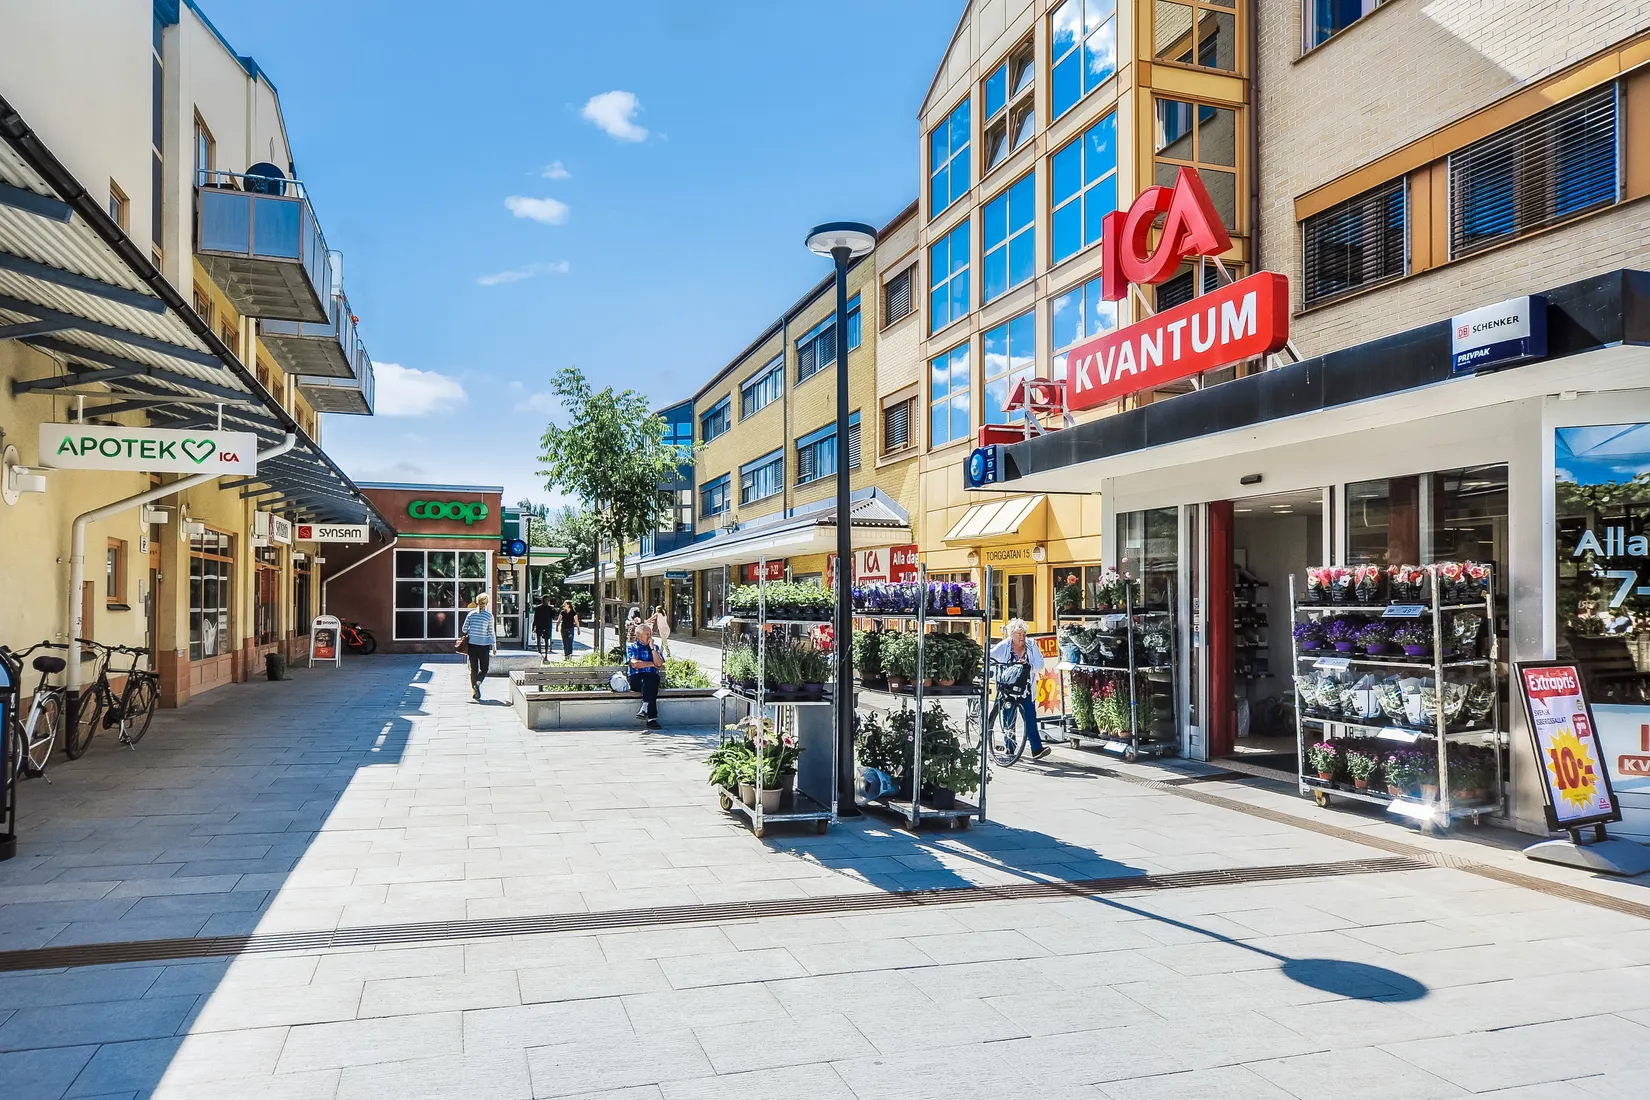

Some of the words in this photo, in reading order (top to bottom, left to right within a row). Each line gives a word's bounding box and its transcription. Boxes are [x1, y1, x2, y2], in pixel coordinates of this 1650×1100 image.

[1101, 166, 1233, 301] ICA
[1472, 315, 1520, 333] SCHENKER
[1075, 290, 1257, 393] KVANTUM
[1457, 347, 1490, 363] PRIVPAK
[57, 435, 177, 460] APOTEK
[219, 451, 240, 462] ICA
[408, 500, 489, 525] coop
[318, 528, 362, 538] SYNSAM
[1573, 526, 1648, 557] Alla
[864, 550, 880, 573] ICA
[892, 550, 905, 566] Alla
[986, 549, 1021, 561] TORGGATAN
[1022, 548, 1030, 559] 15
[1528, 673, 1576, 693] Extrapris
